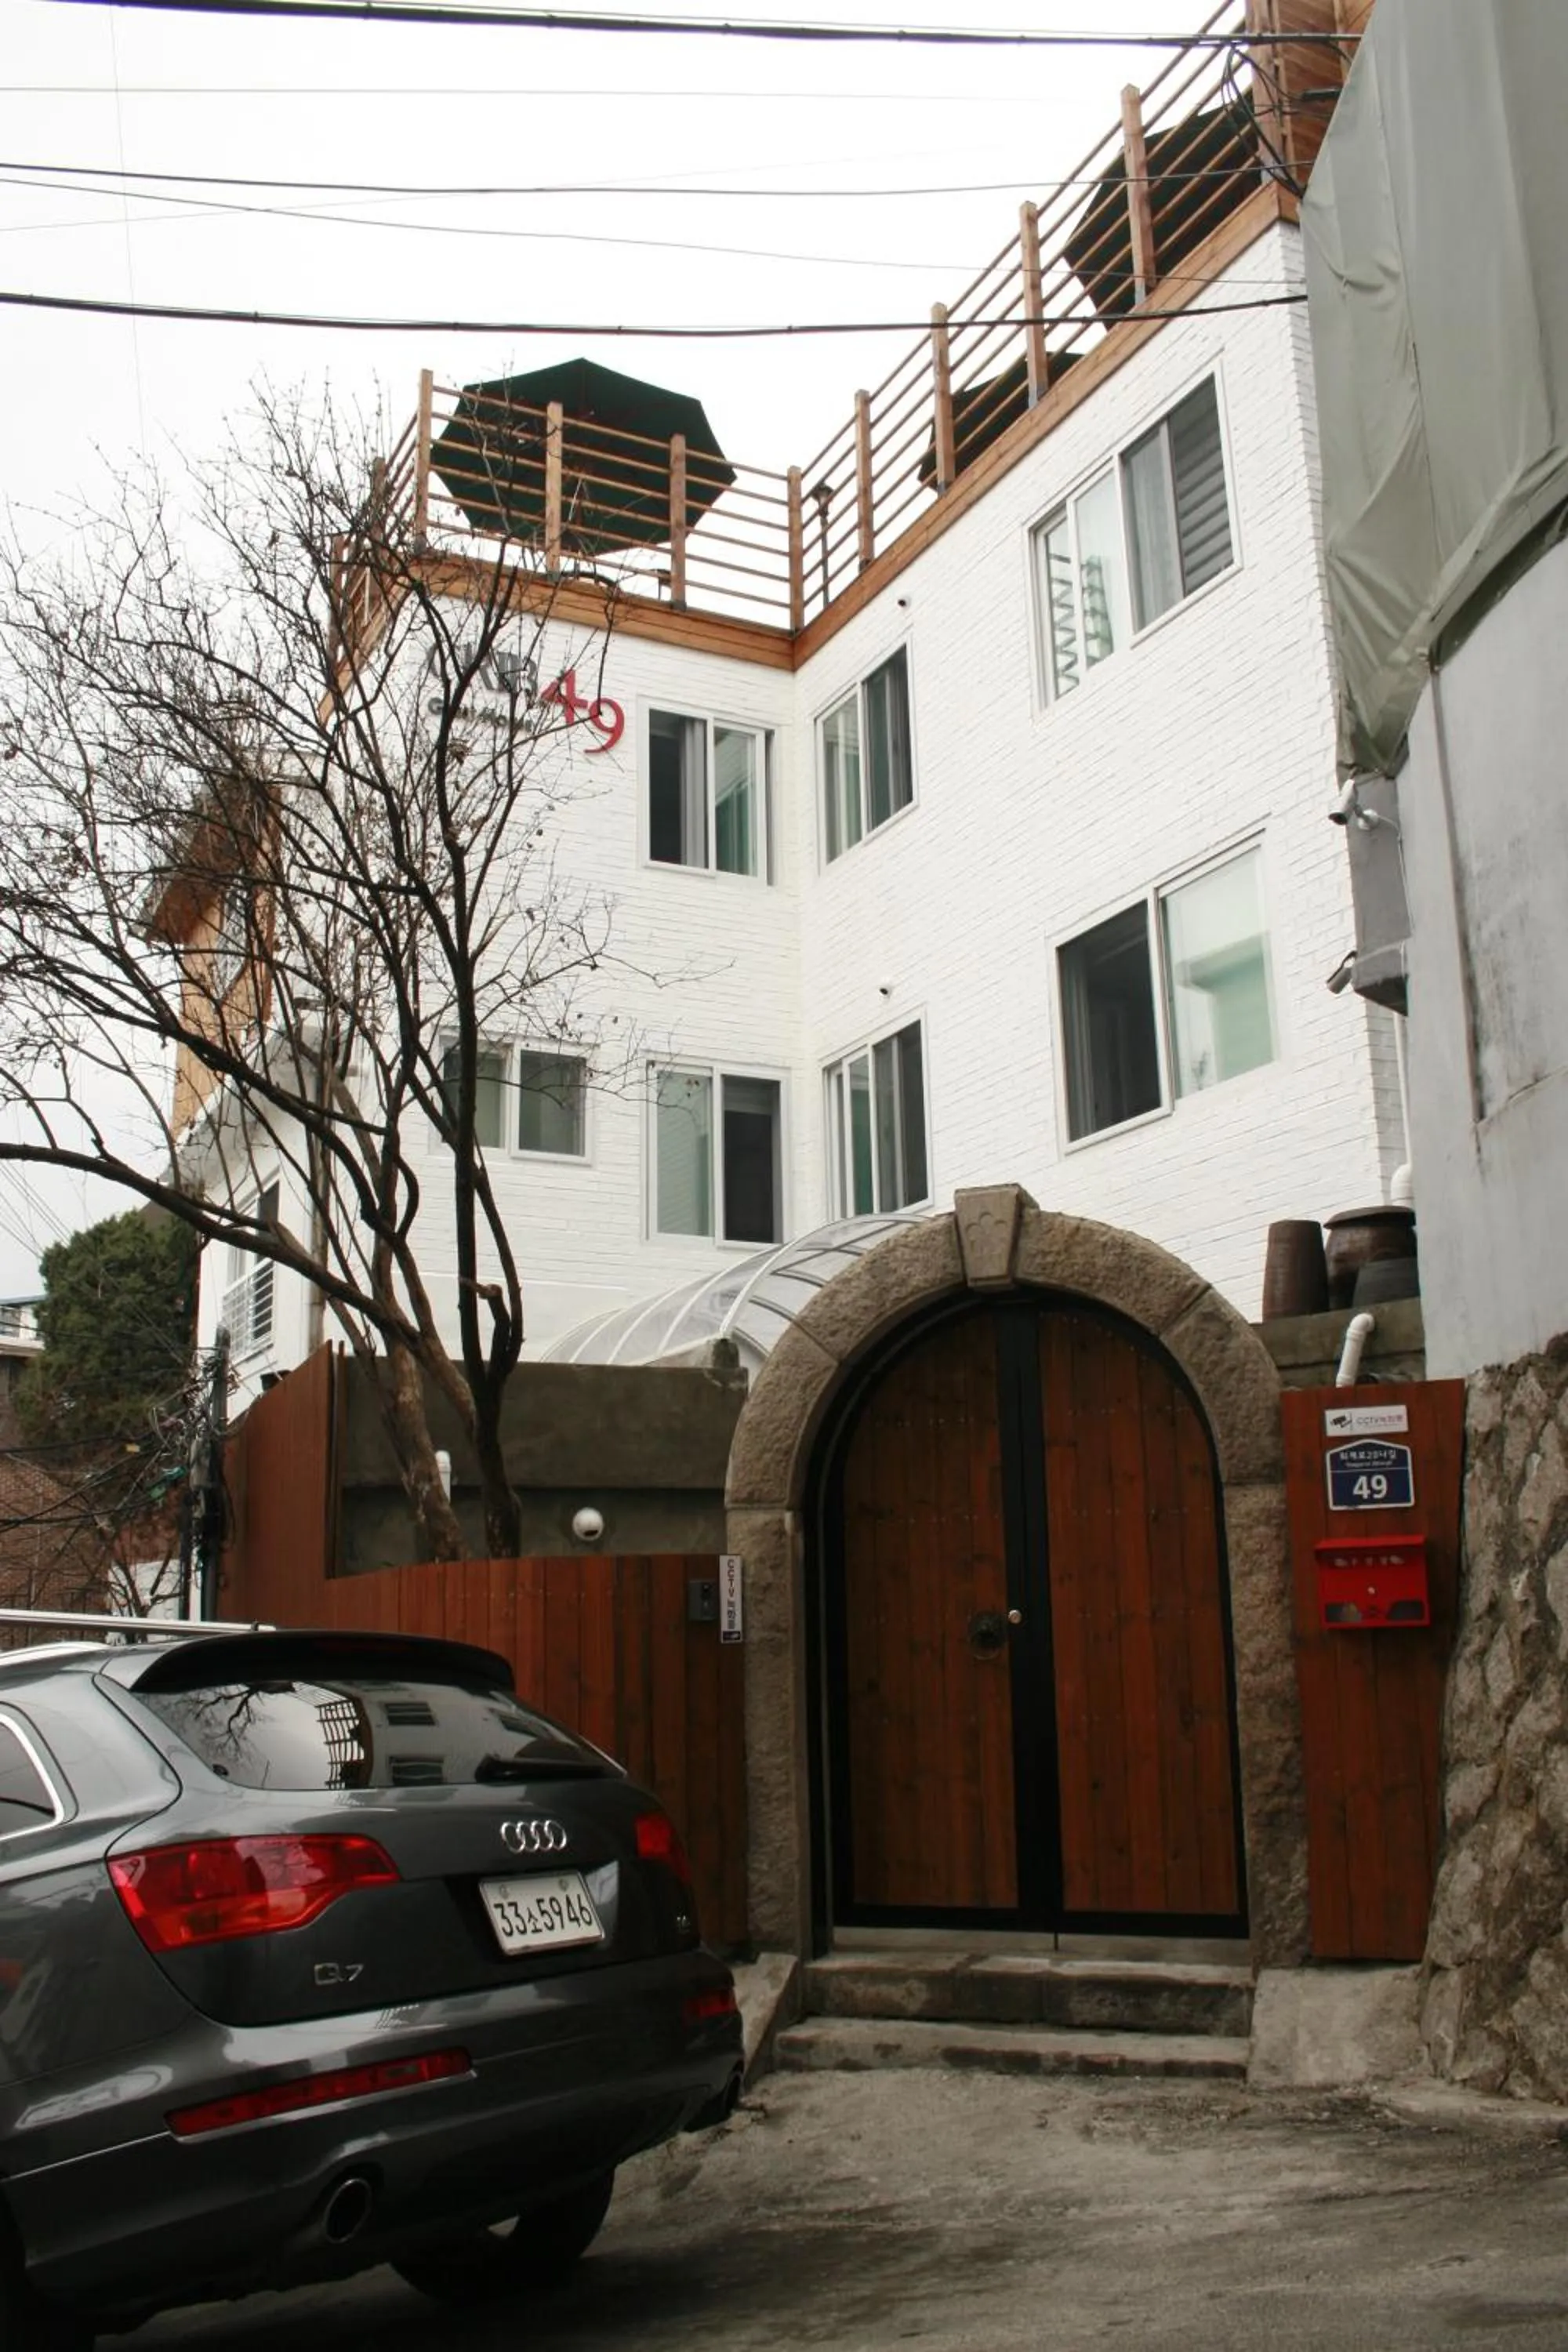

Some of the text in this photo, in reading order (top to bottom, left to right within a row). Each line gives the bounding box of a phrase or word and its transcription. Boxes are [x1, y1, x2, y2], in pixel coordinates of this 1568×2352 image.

[540, 666, 625, 753] 49
[1352, 1475, 1388, 1500] 49
[493, 1893, 593, 1937] 33소5946
[314, 1962, 364, 1985] Q7
